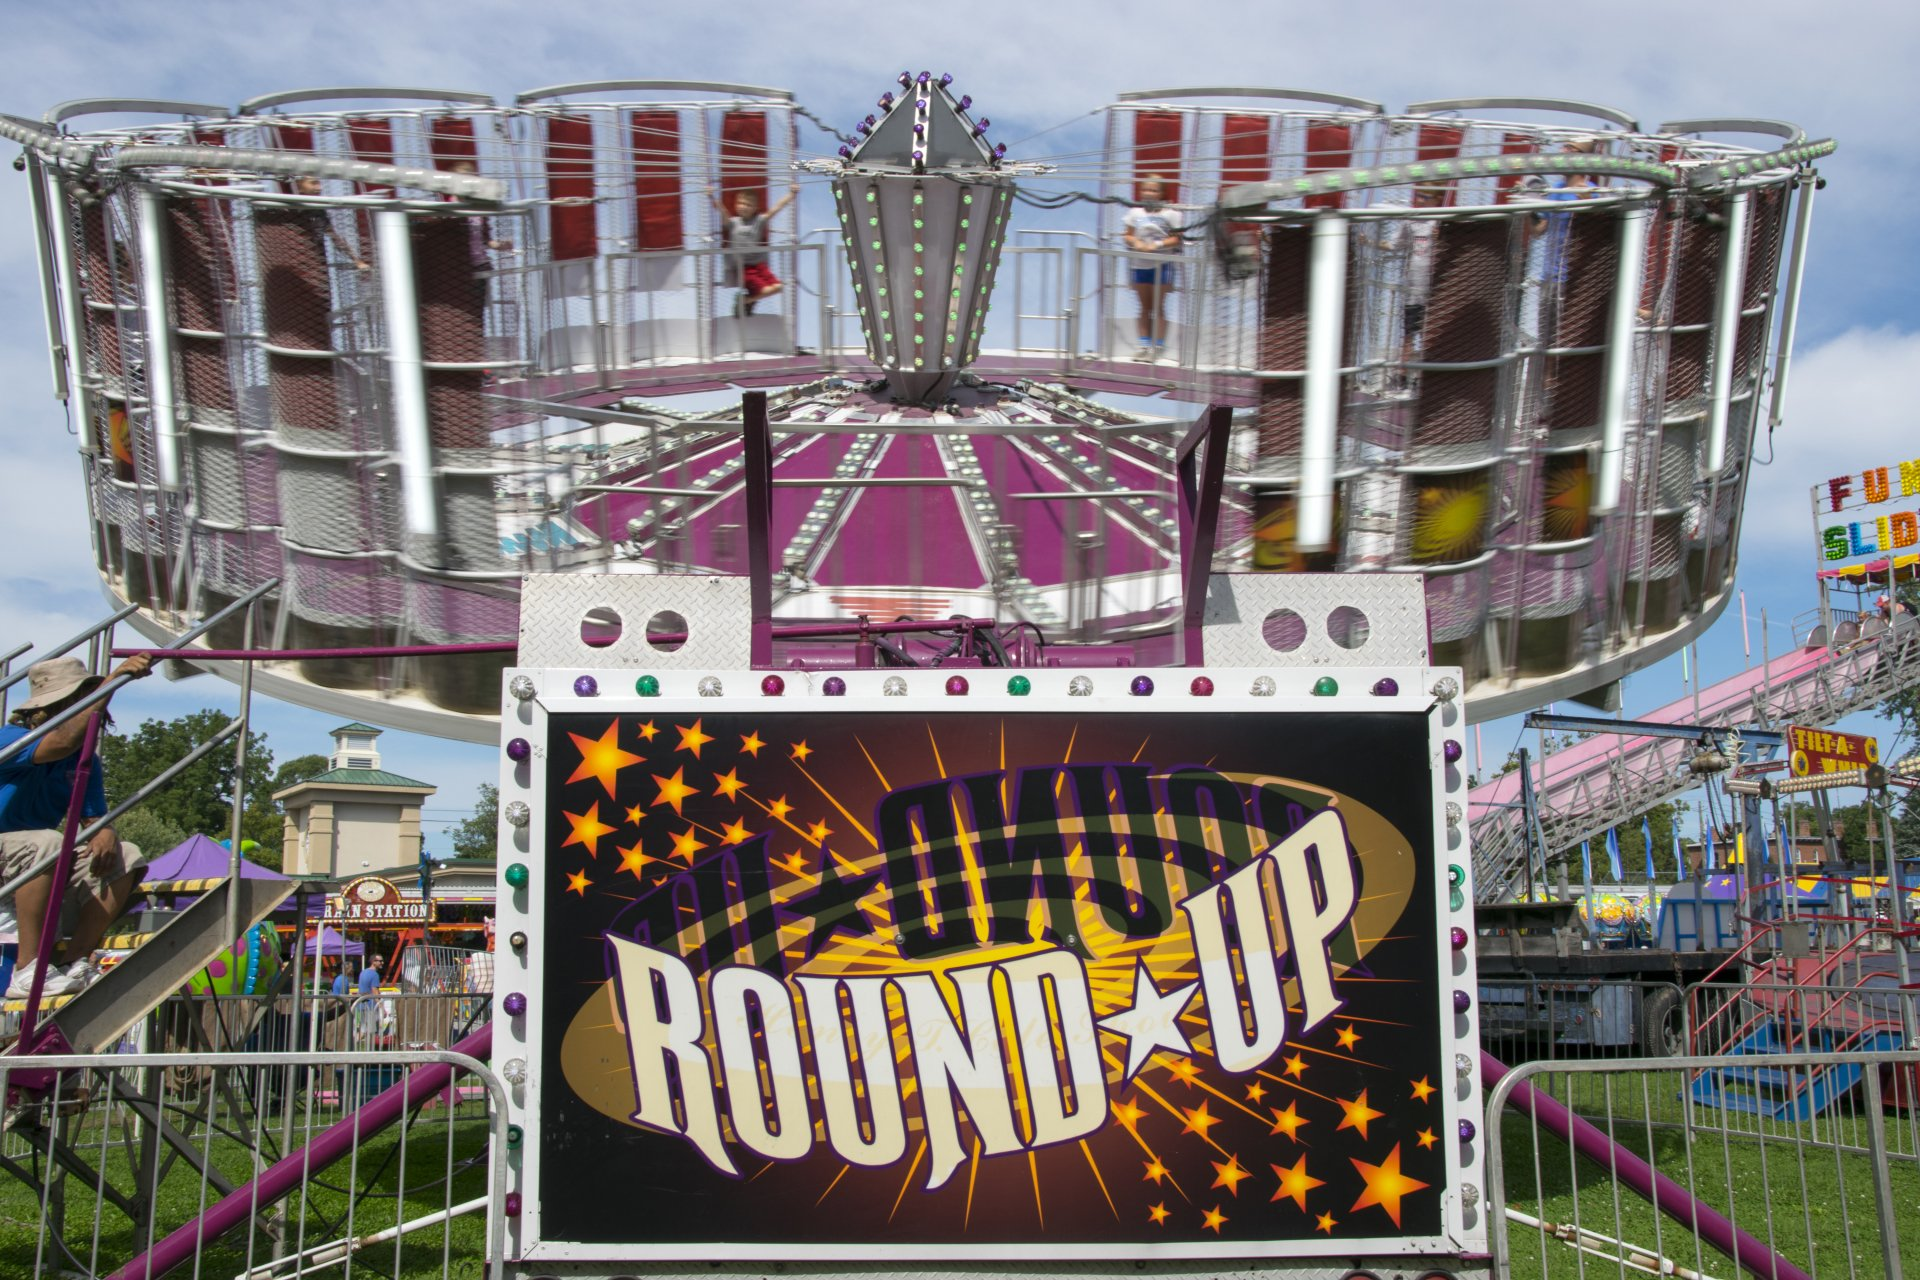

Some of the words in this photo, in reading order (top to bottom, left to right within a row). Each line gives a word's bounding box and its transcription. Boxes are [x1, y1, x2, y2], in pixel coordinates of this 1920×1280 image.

[1828, 458, 1920, 512] FUN
[1823, 509, 1920, 560] SLID
[365, 904, 428, 918] STATION
[604, 931, 1109, 1192] ROUND
[1182, 804, 1362, 1074] UP
